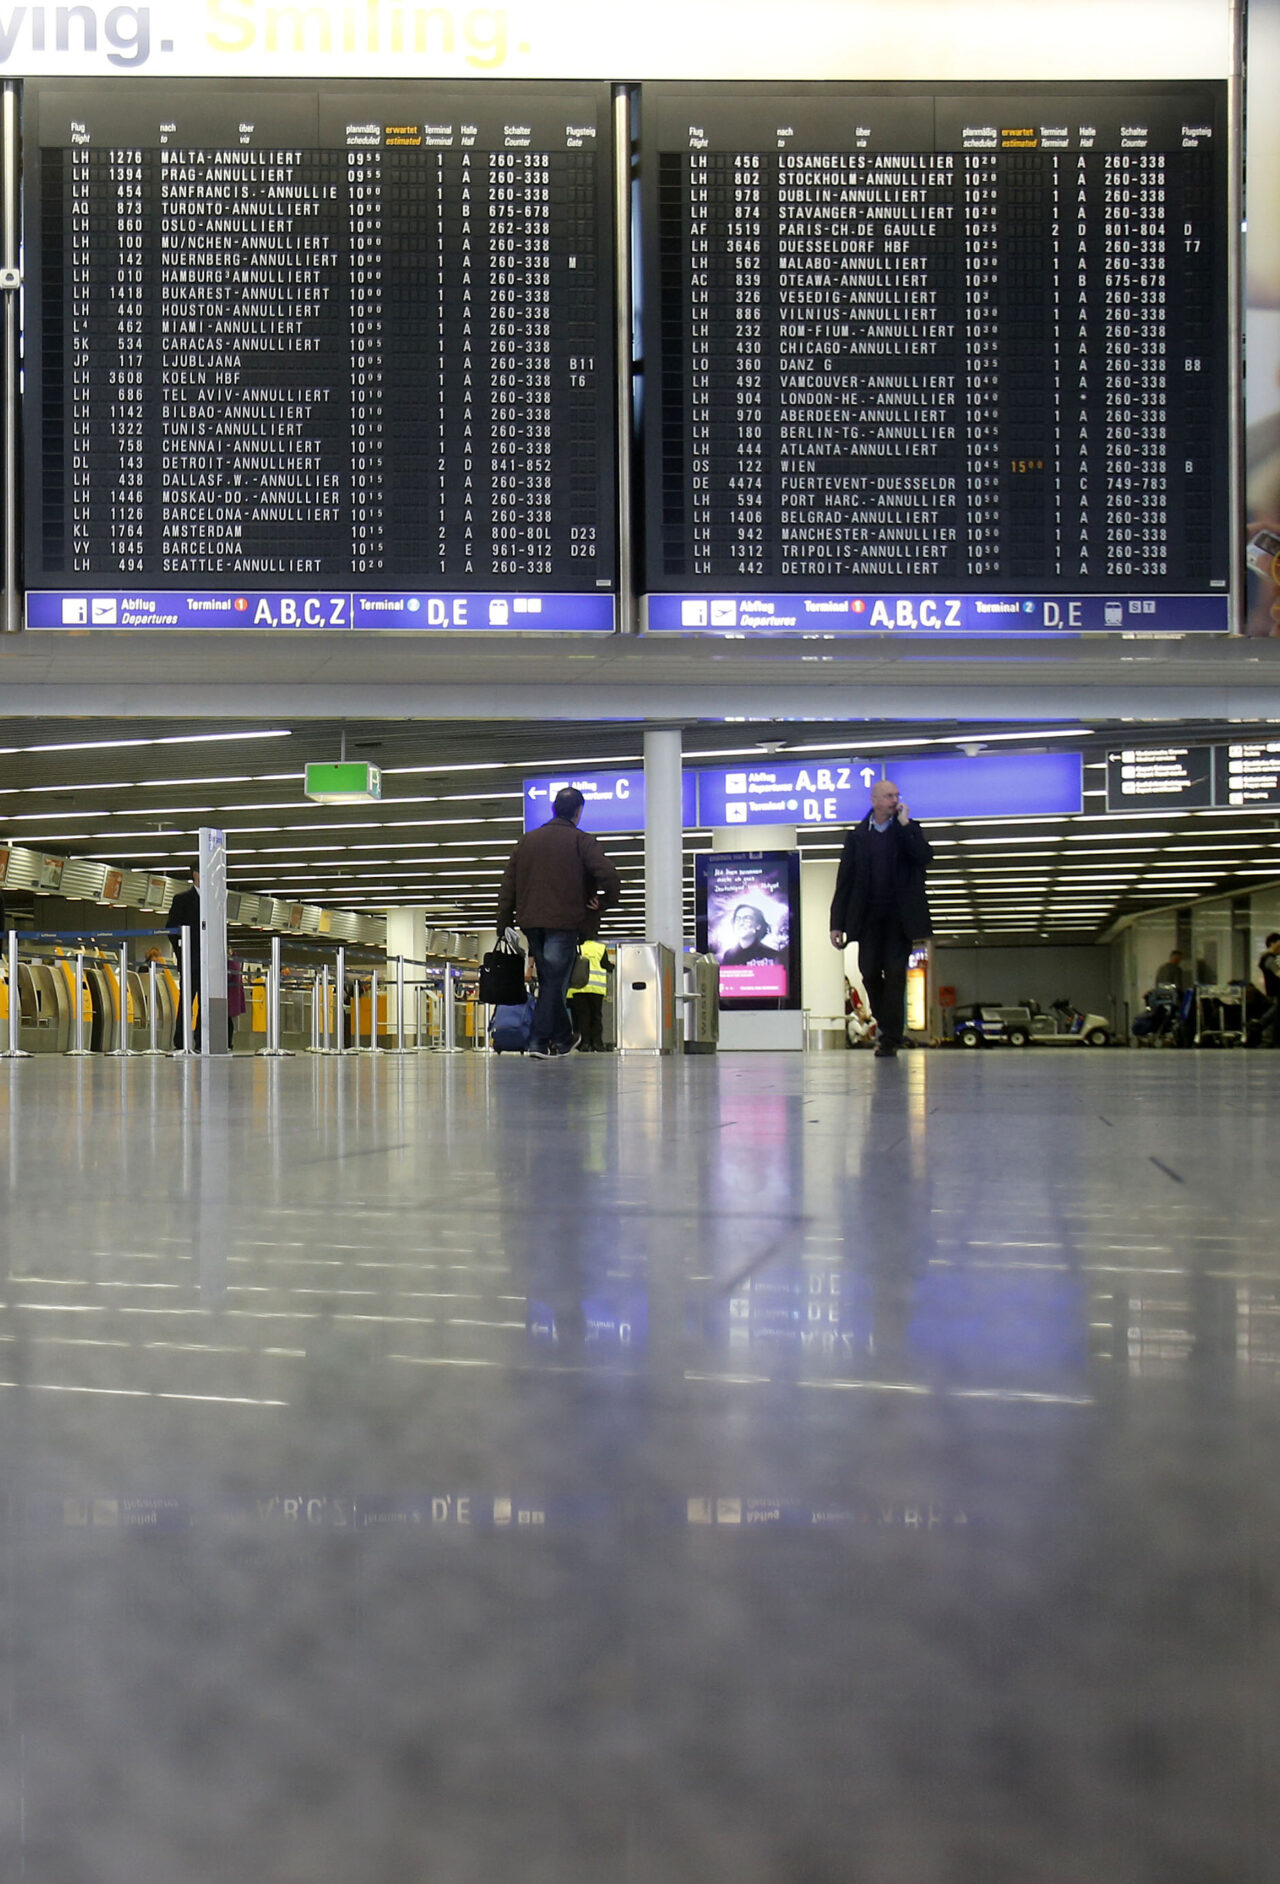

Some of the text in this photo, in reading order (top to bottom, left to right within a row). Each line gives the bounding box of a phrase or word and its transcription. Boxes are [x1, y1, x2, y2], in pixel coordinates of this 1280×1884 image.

[205, 0, 531, 69] Smiling.
[72, 150, 549, 167] LH 1276 MALTA-ANNULLIERT 260-338
[690, 155, 1165, 169] LH 456 LOSANGELES-ANNULLIER 260-338
[691, 239, 1201, 253] LH 3646 DUESSELDORF HBF T7
[73, 303, 320, 317] LH 440 HOUSTON-ANNULLIERT
[73, 353, 594, 370] JP 117 LJUBLJANA B11
[692, 459, 816, 473] OS 122 WIEN
[73, 523, 596, 540] KL 1764 AMSTERDAM D23
[118, 558, 552, 574] 494 SEATTLE-ANNULLIERT 260-338
[738, 561, 1167, 575] 442 DETROIT-ANNULLIERT 260-338
[120, 598, 156, 613] Abflug
[186, 598, 232, 611] Terminal
[359, 598, 404, 611] Terminal
[427, 598, 468, 628] D,E
[739, 599, 775, 614] Abflug
[121, 613, 178, 627] Departures
[739, 614, 797, 628] Departures
[803, 600, 849, 613] Terminal
[974, 600, 1020, 614] Terminal
[1042, 601, 1083, 630] D,E
[615, 778, 630, 800] C
[803, 798, 837, 821] D,E
